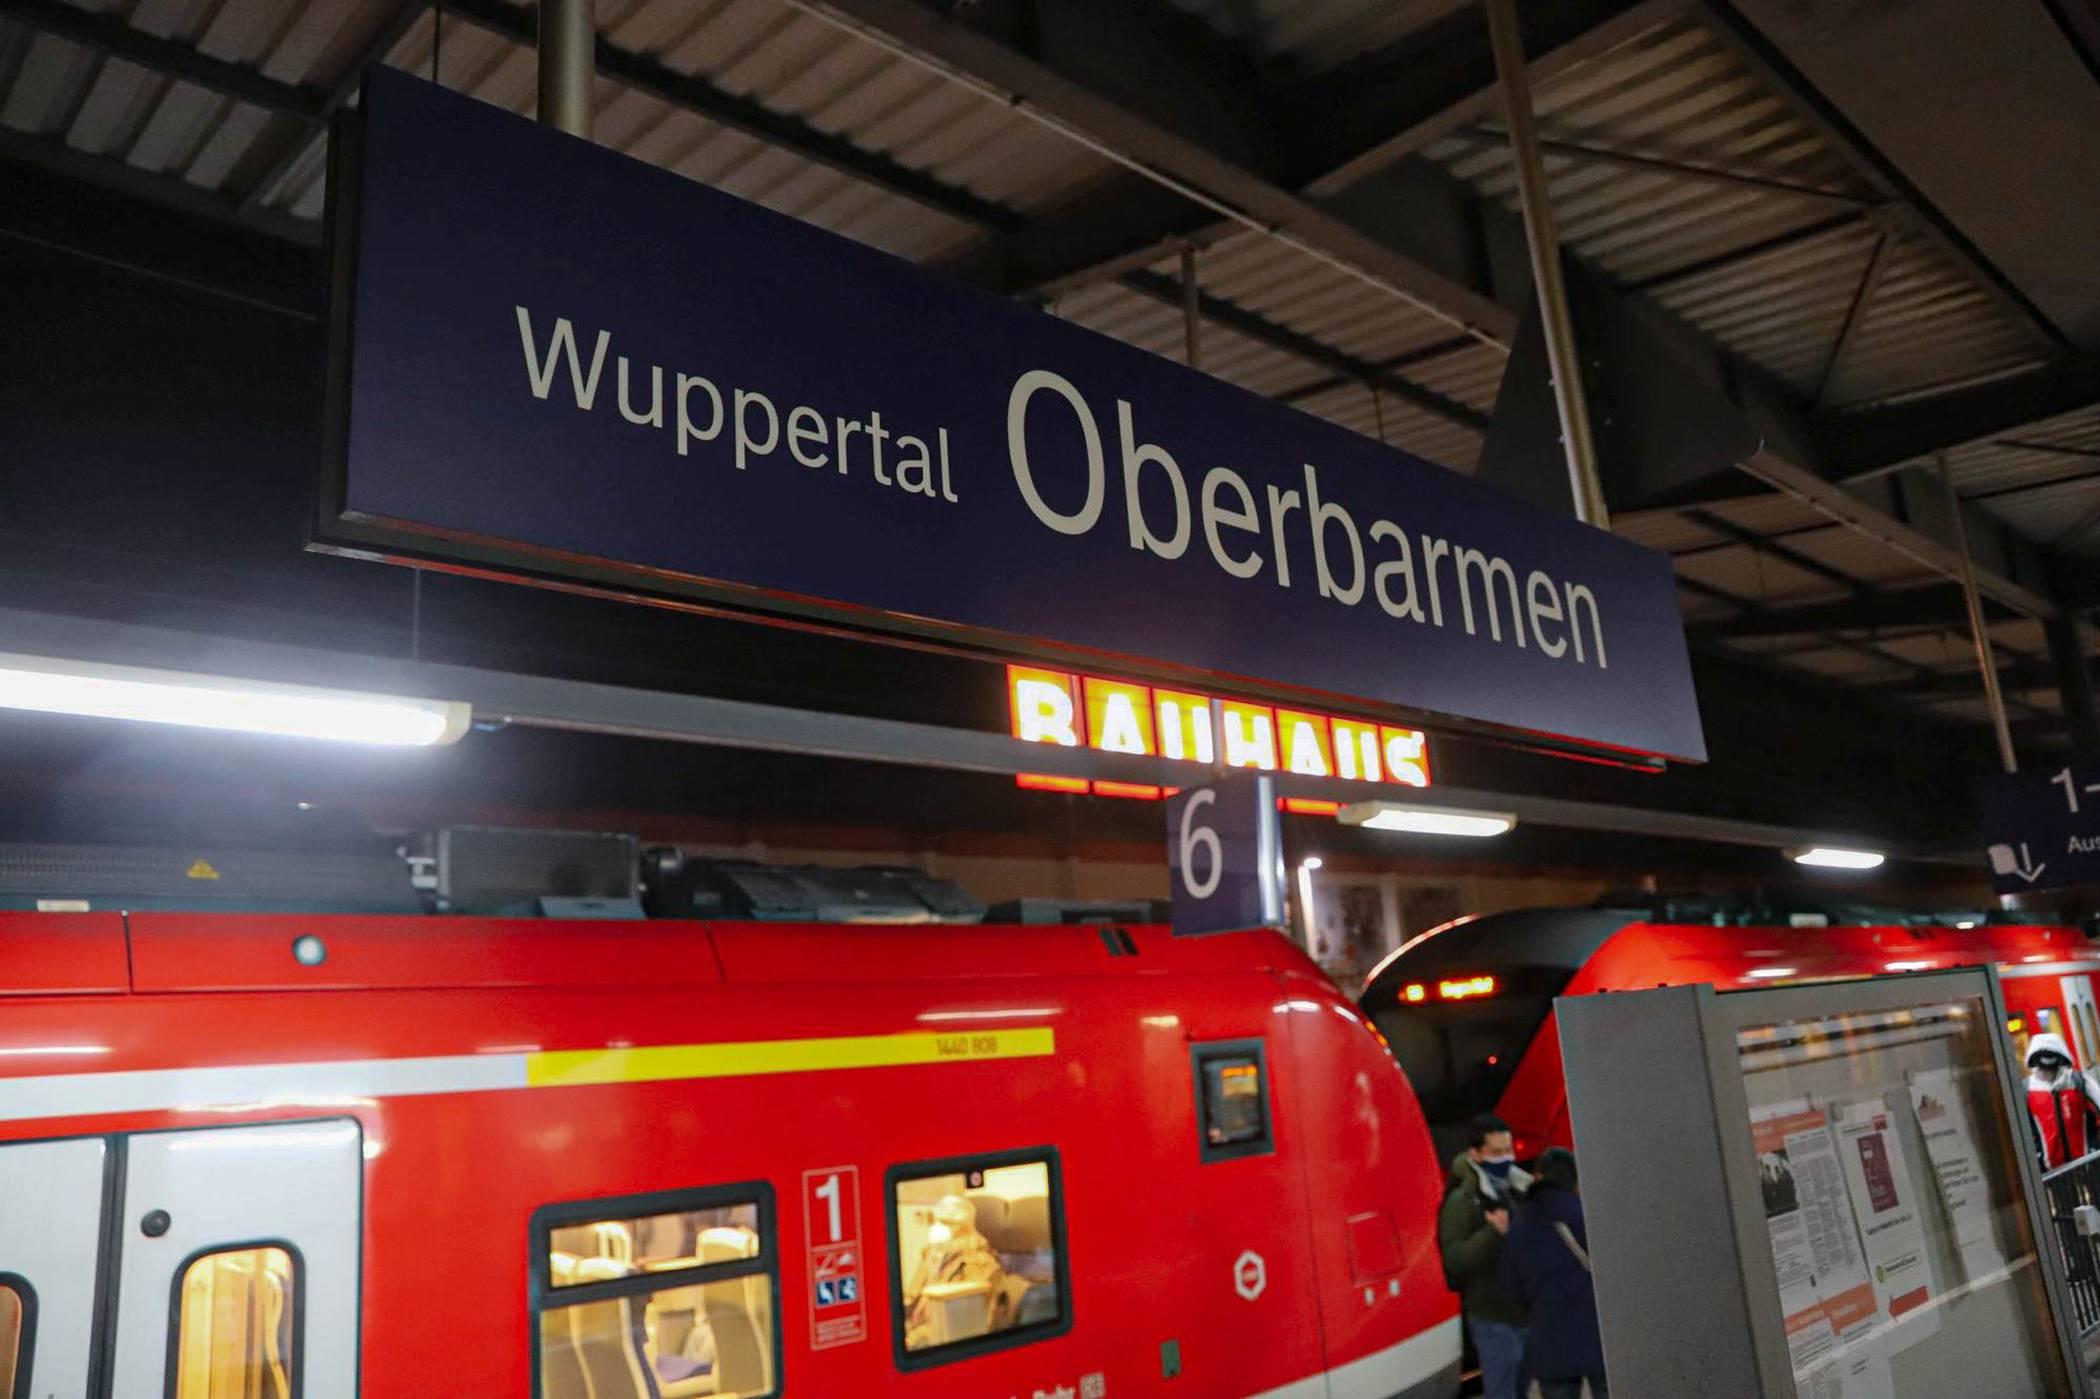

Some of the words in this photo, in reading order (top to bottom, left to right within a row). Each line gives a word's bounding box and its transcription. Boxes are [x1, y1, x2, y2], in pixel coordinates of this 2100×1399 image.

[516, 305, 958, 502] Wuppertal
[1007, 369, 1607, 668] Oberbarmen
[1016, 679, 1427, 787] BAUHAUS
[1180, 788, 1223, 900] 6
[815, 1174, 842, 1242] 1
